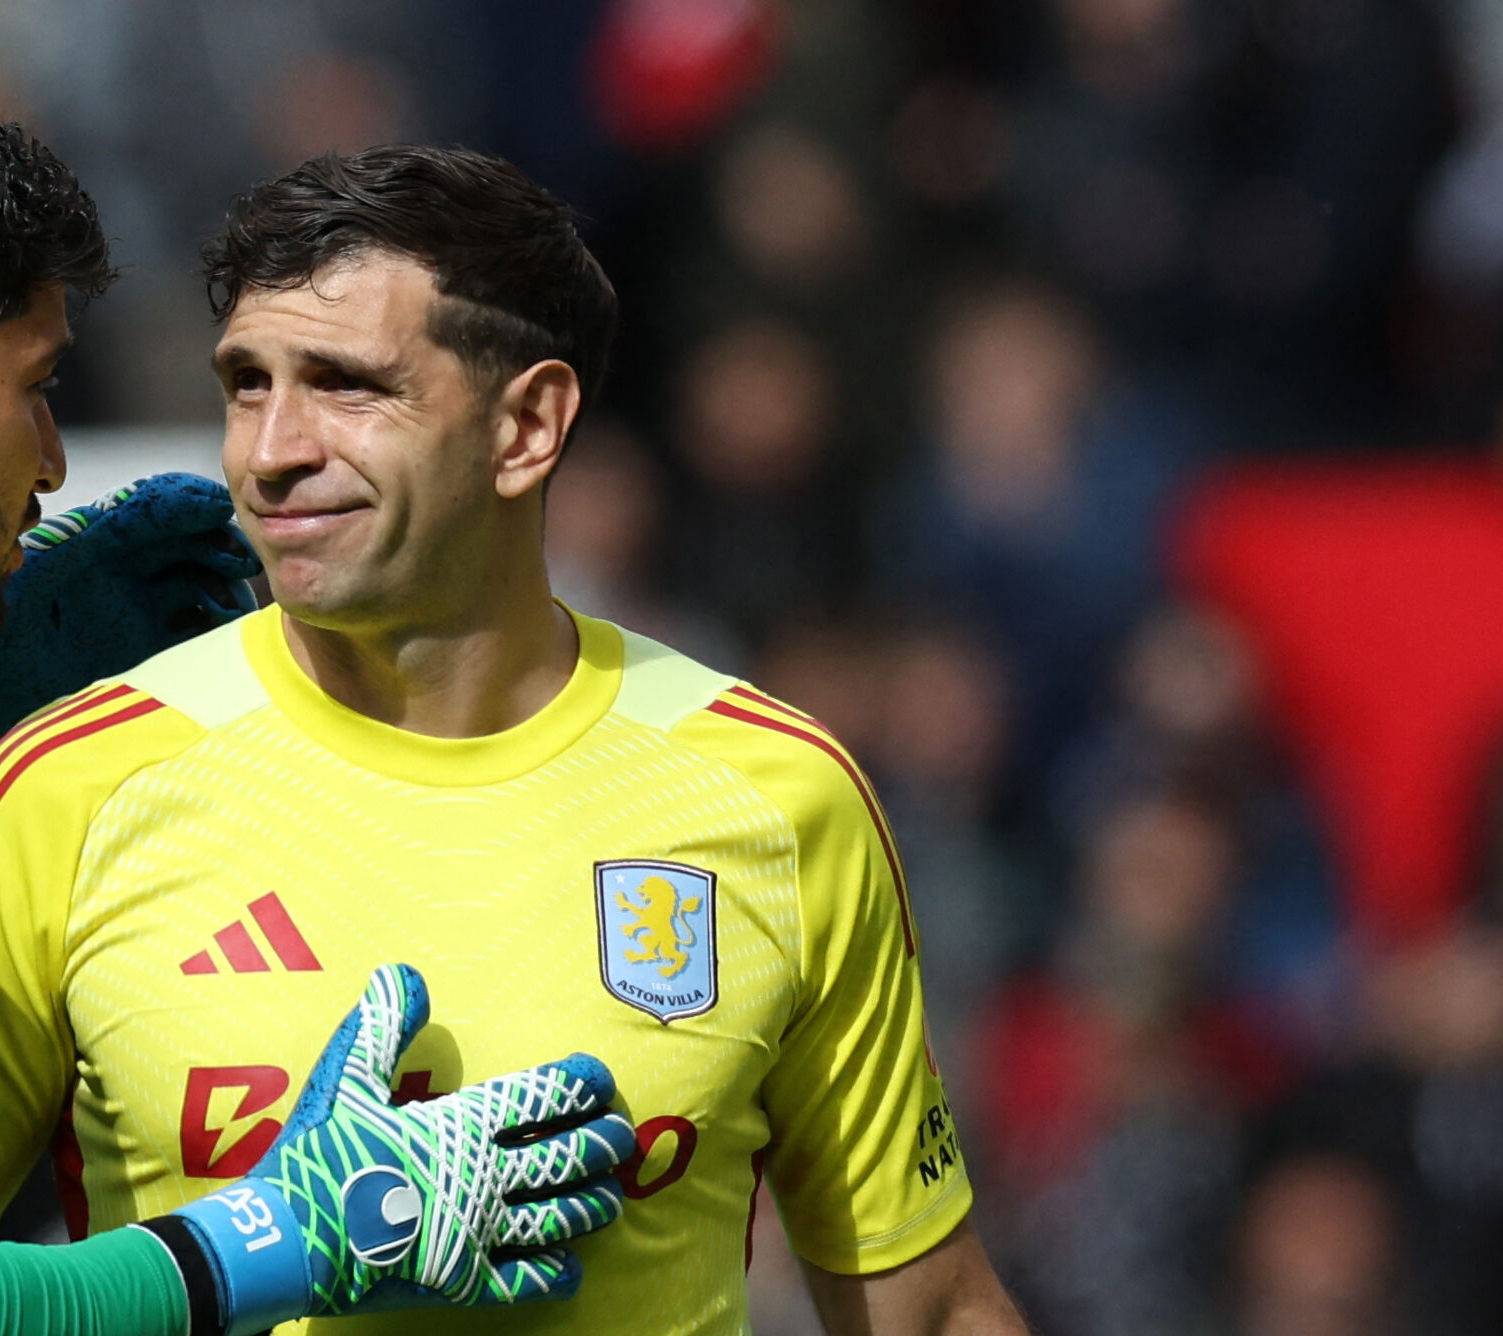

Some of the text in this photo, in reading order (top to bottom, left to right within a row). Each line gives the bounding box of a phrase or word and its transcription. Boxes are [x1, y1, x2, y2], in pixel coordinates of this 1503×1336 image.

[616, 979, 705, 1007] ASTON VILLA
[919, 1131, 960, 1188] NAT
